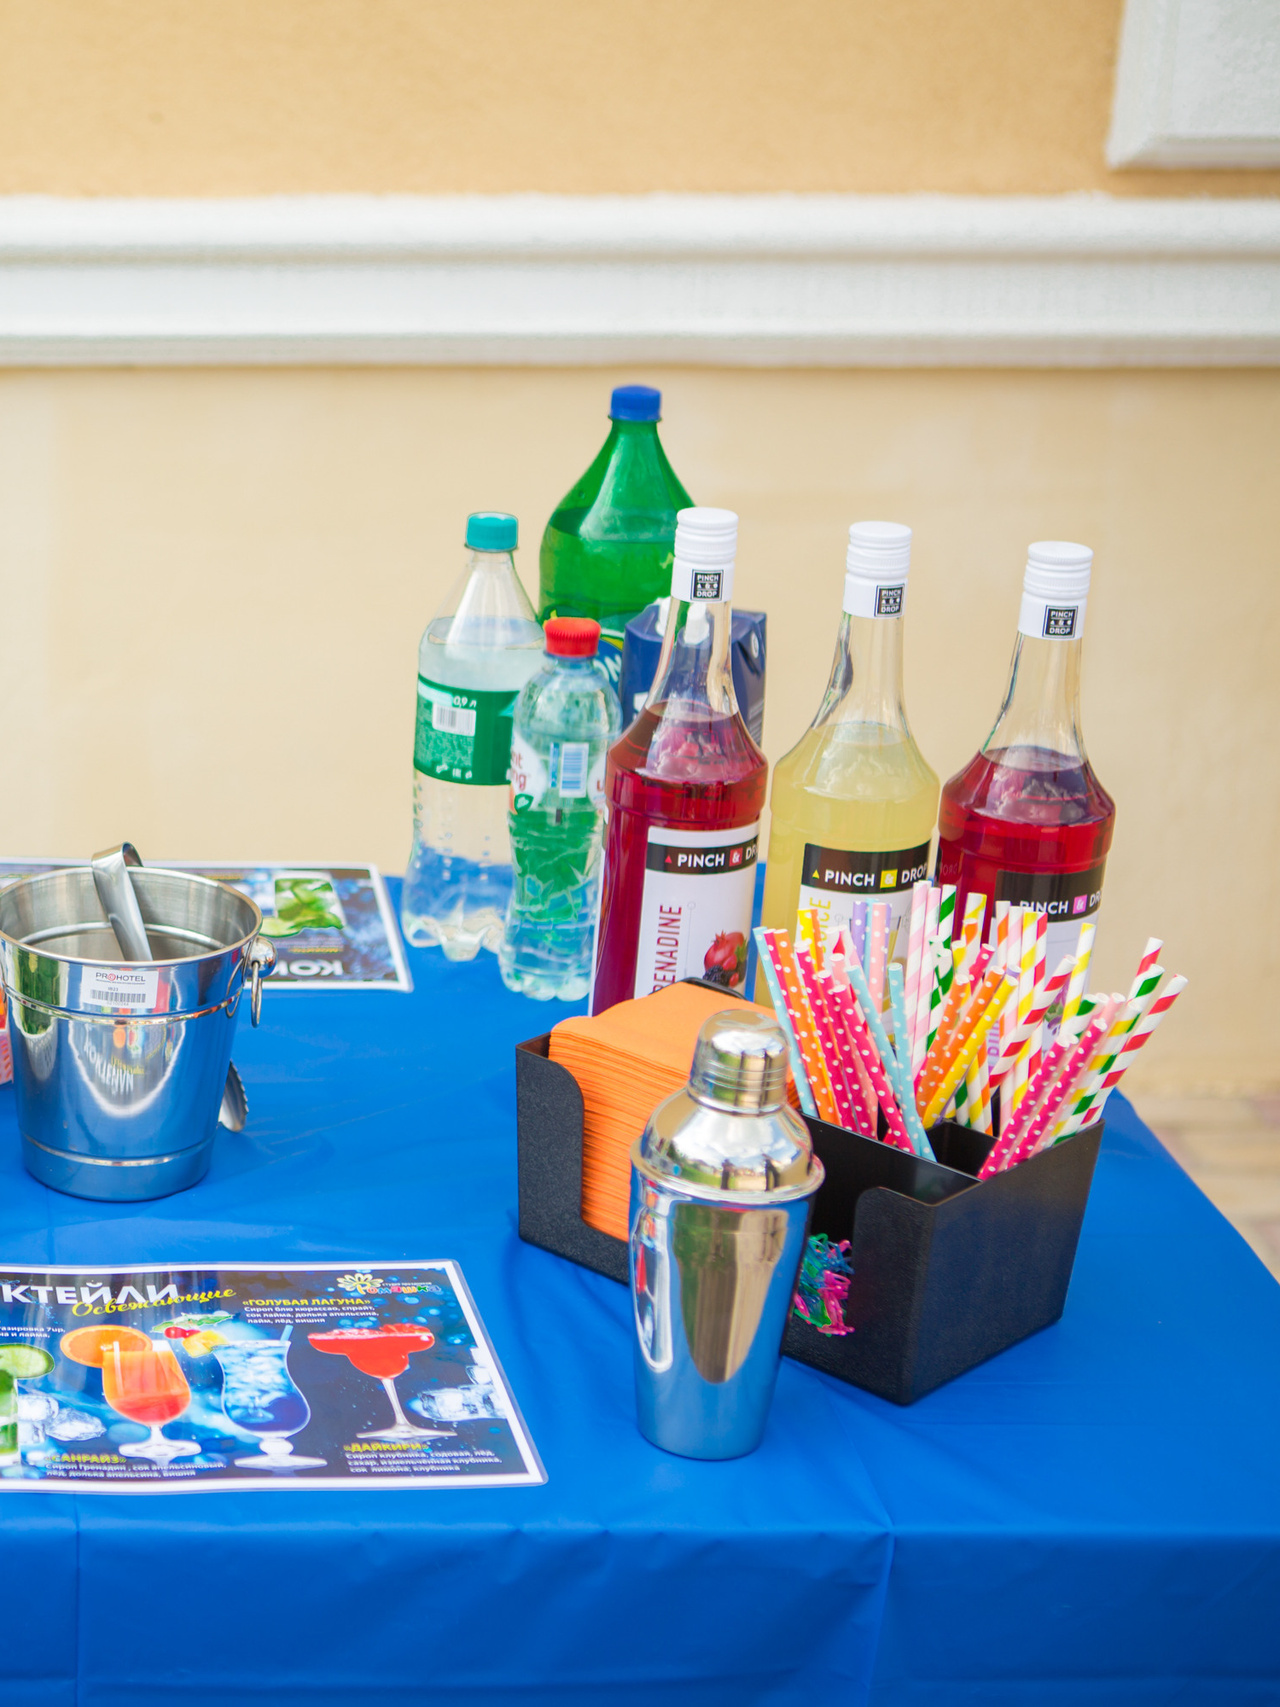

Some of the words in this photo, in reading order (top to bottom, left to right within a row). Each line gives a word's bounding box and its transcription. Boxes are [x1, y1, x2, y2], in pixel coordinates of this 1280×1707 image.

[697, 574, 719, 582] PINCH
[1050, 610, 1074, 618] PINCH
[677, 853, 725, 868] PINCH
[732, 852, 740, 864] &
[824, 869, 875, 887] PINCH
[884, 873, 894, 885] &
[1076, 896, 1085, 910] &
[72, 1287, 237, 1317] Освежающие
